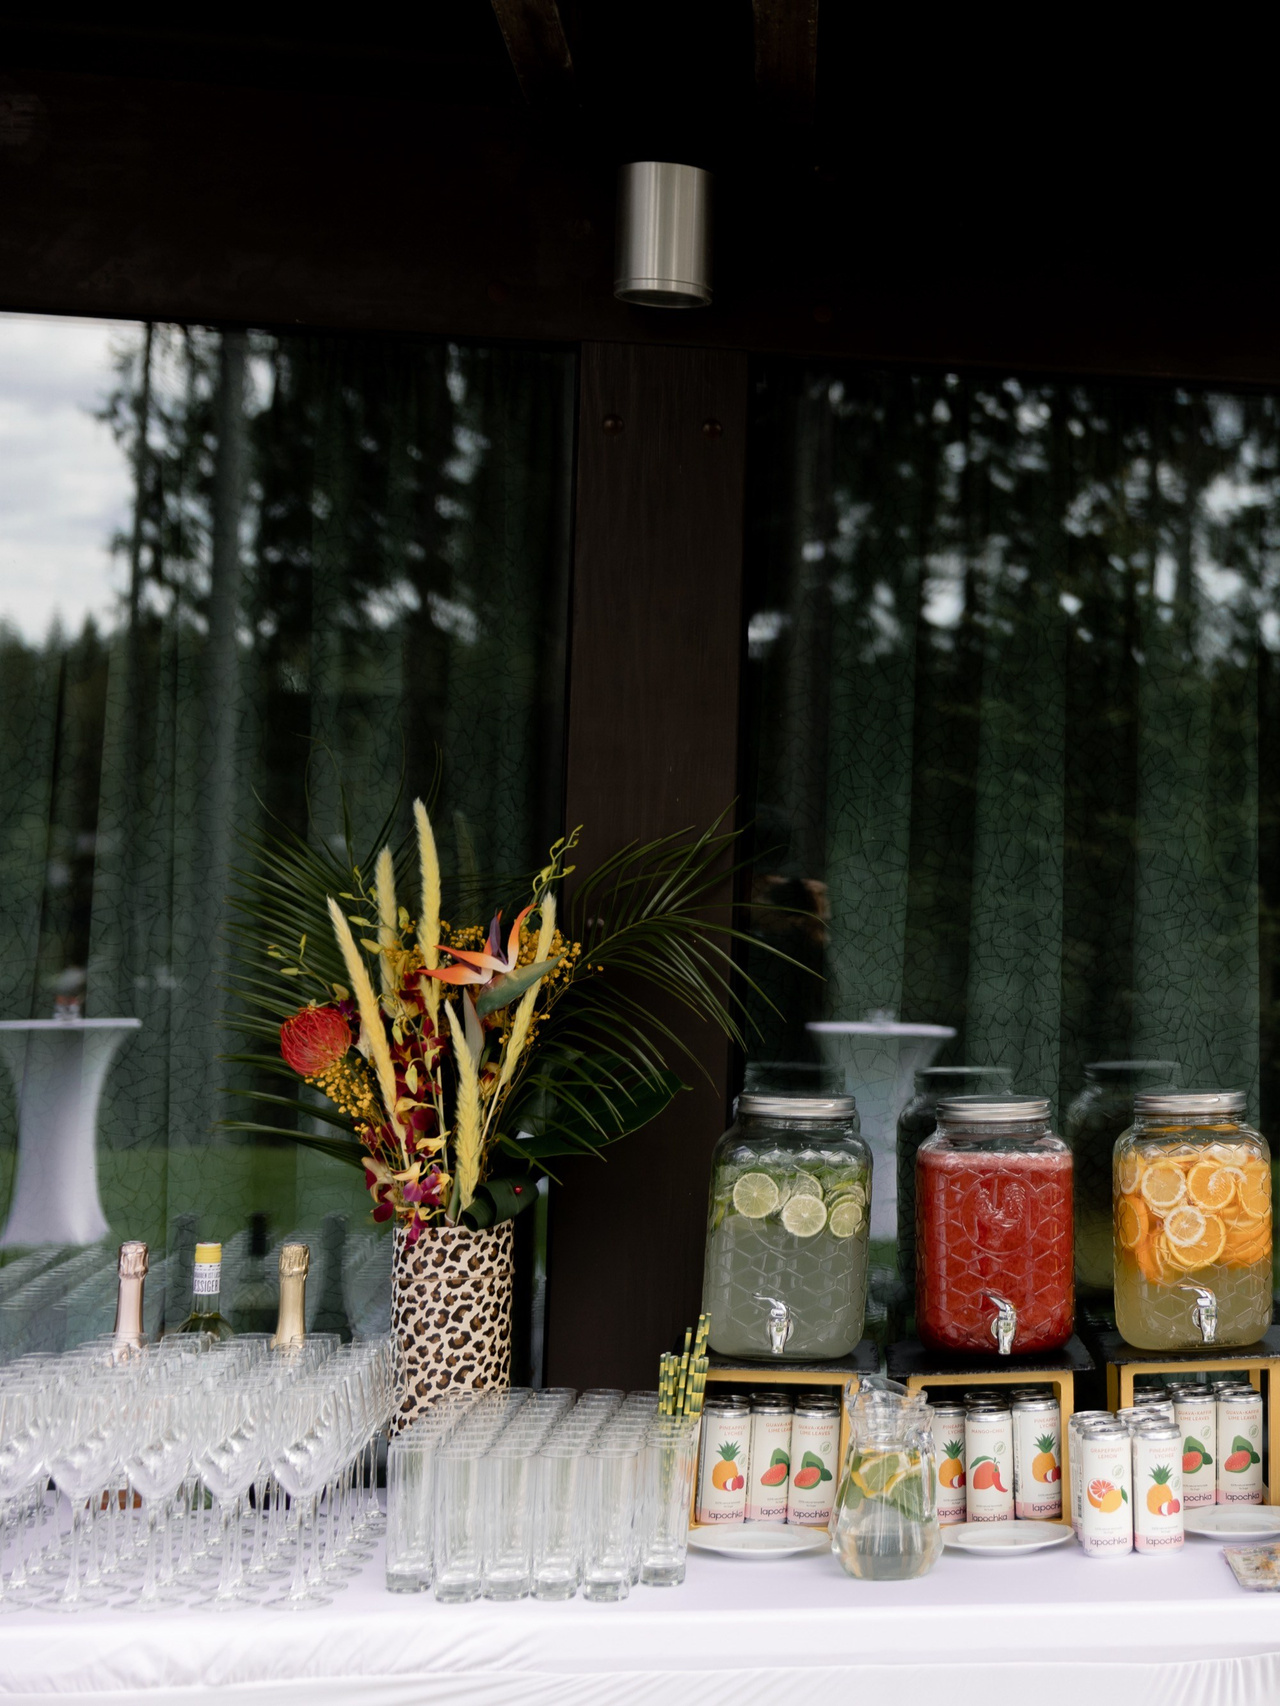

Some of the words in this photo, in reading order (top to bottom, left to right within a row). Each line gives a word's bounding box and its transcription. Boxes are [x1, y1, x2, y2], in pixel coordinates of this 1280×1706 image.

[1183, 1492, 1212, 1503] pochka
[1225, 1491, 1260, 1502] lapochka
[792, 1509, 829, 1521] lapochka
[1089, 1537, 1127, 1547] lapochka
[1145, 1535, 1182, 1547] lapochka
